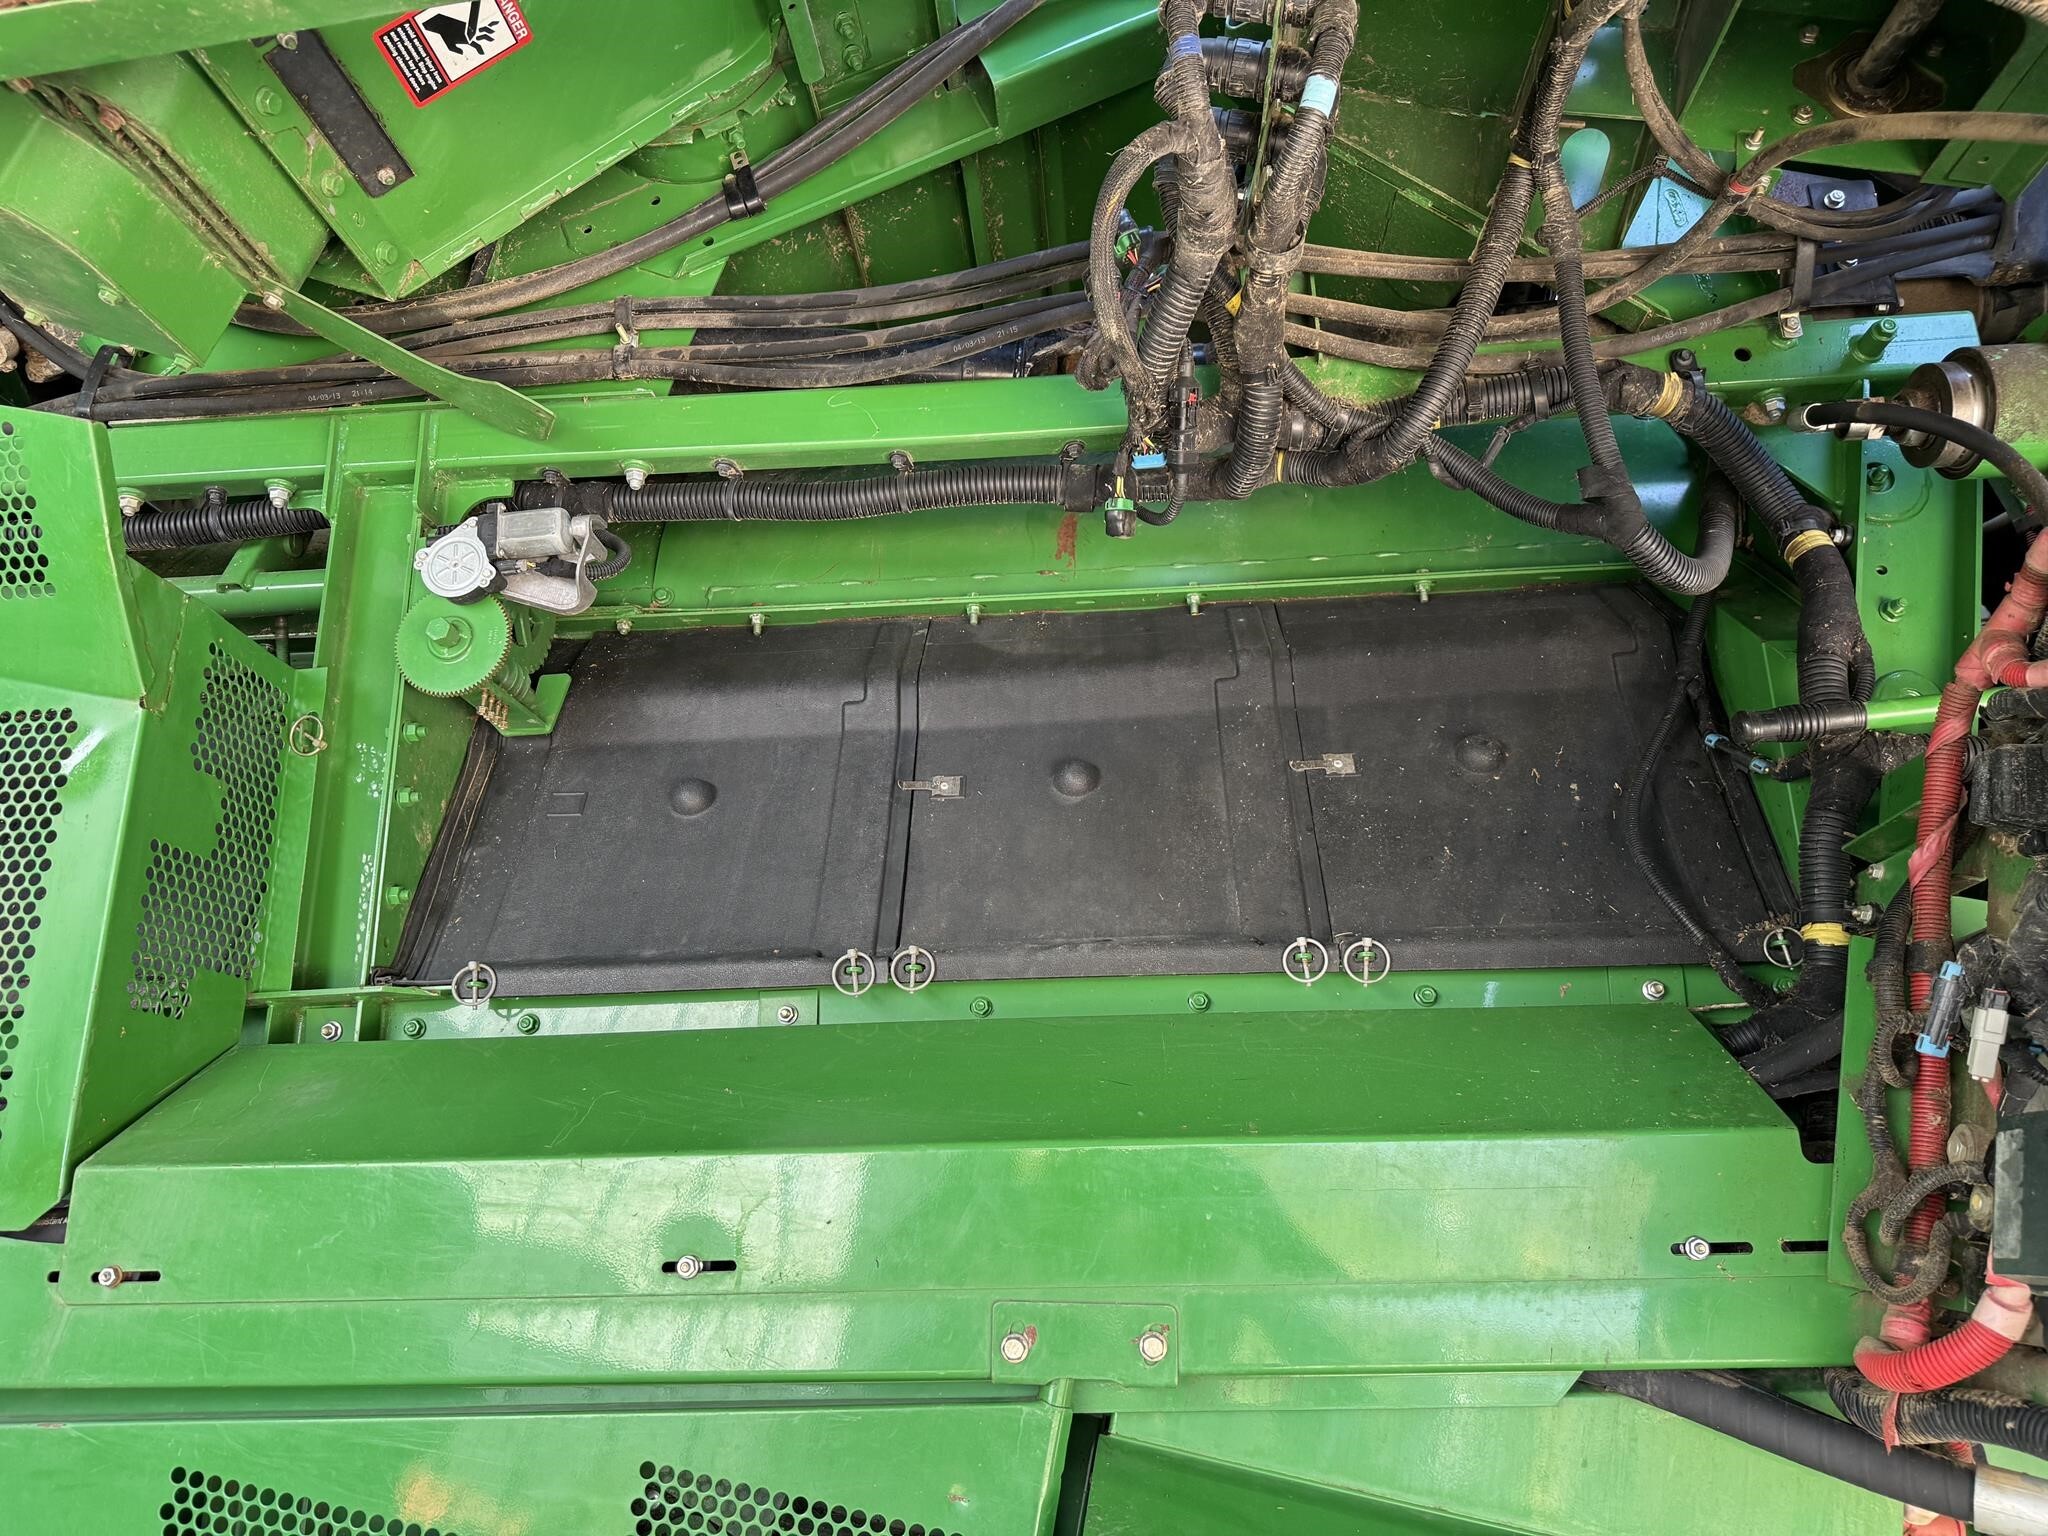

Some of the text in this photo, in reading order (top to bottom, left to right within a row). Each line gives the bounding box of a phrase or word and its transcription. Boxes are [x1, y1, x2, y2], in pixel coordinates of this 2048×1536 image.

[500, 0, 528, 40] ANGER
[383, 35, 420, 93] opening cleanout doors.
[390, 31, 425, 85] and remove key before
[397, 27, 437, 90] entanglement. Stop engine
[403, 23, 442, 83] Avoid serious injury from
[953, 336, 986, 353] 04/03/13
